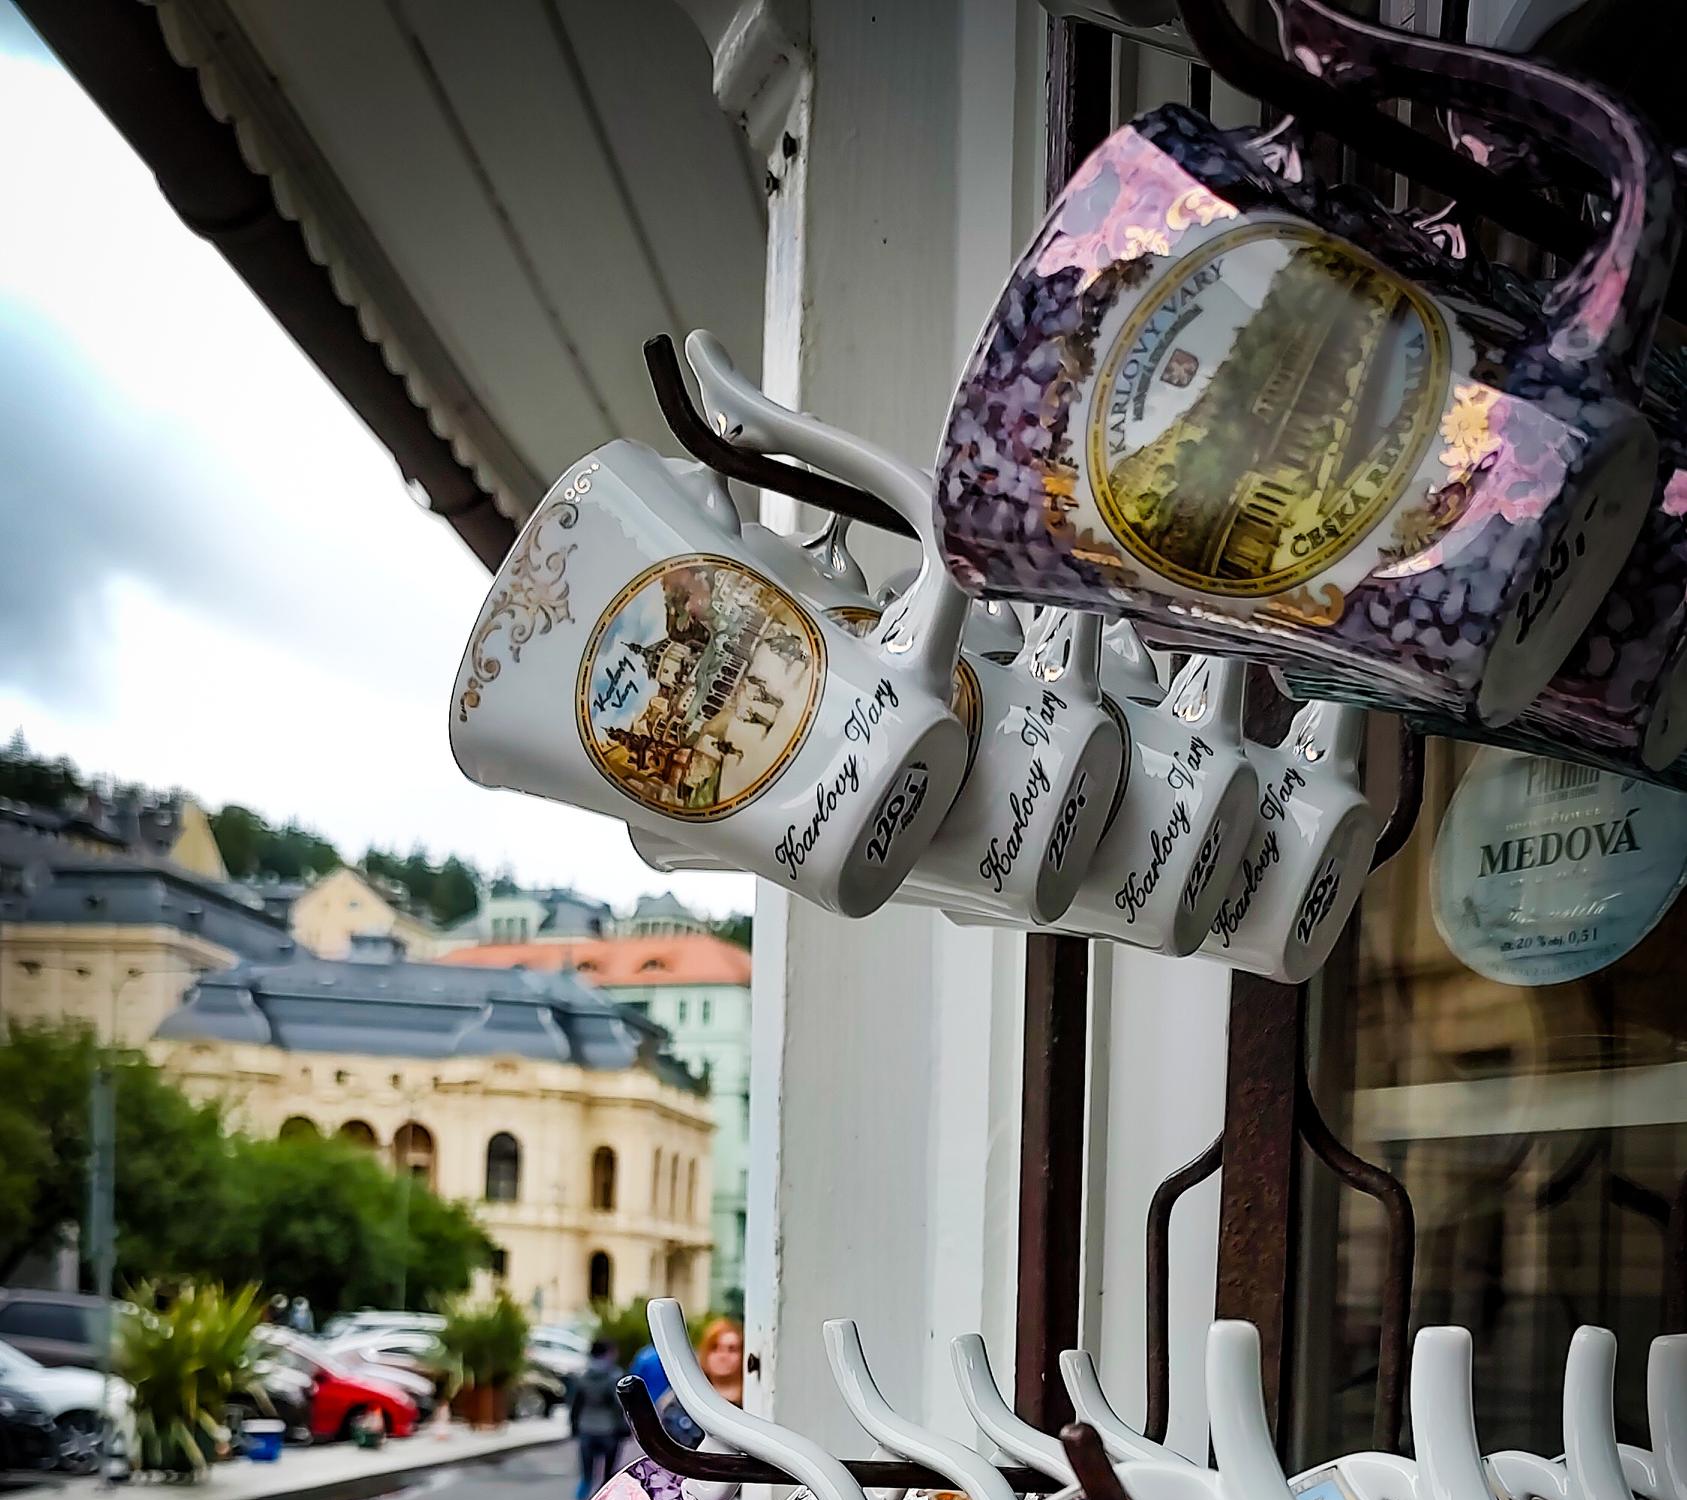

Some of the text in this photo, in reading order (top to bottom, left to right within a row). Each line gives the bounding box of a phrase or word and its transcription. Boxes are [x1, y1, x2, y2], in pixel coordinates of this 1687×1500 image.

[1109, 318, 1161, 457] KARLOVY
[1163, 258, 1225, 316] VARY
[775, 678, 899, 881] Karlovy Vary
[980, 689, 1067, 893] Karlovy Vary
[1115, 735, 1214, 925] Karlovy Vary
[1211, 767, 1306, 948] Karlovy Vary
[1477, 807, 1642, 878] MEDOVÁ
